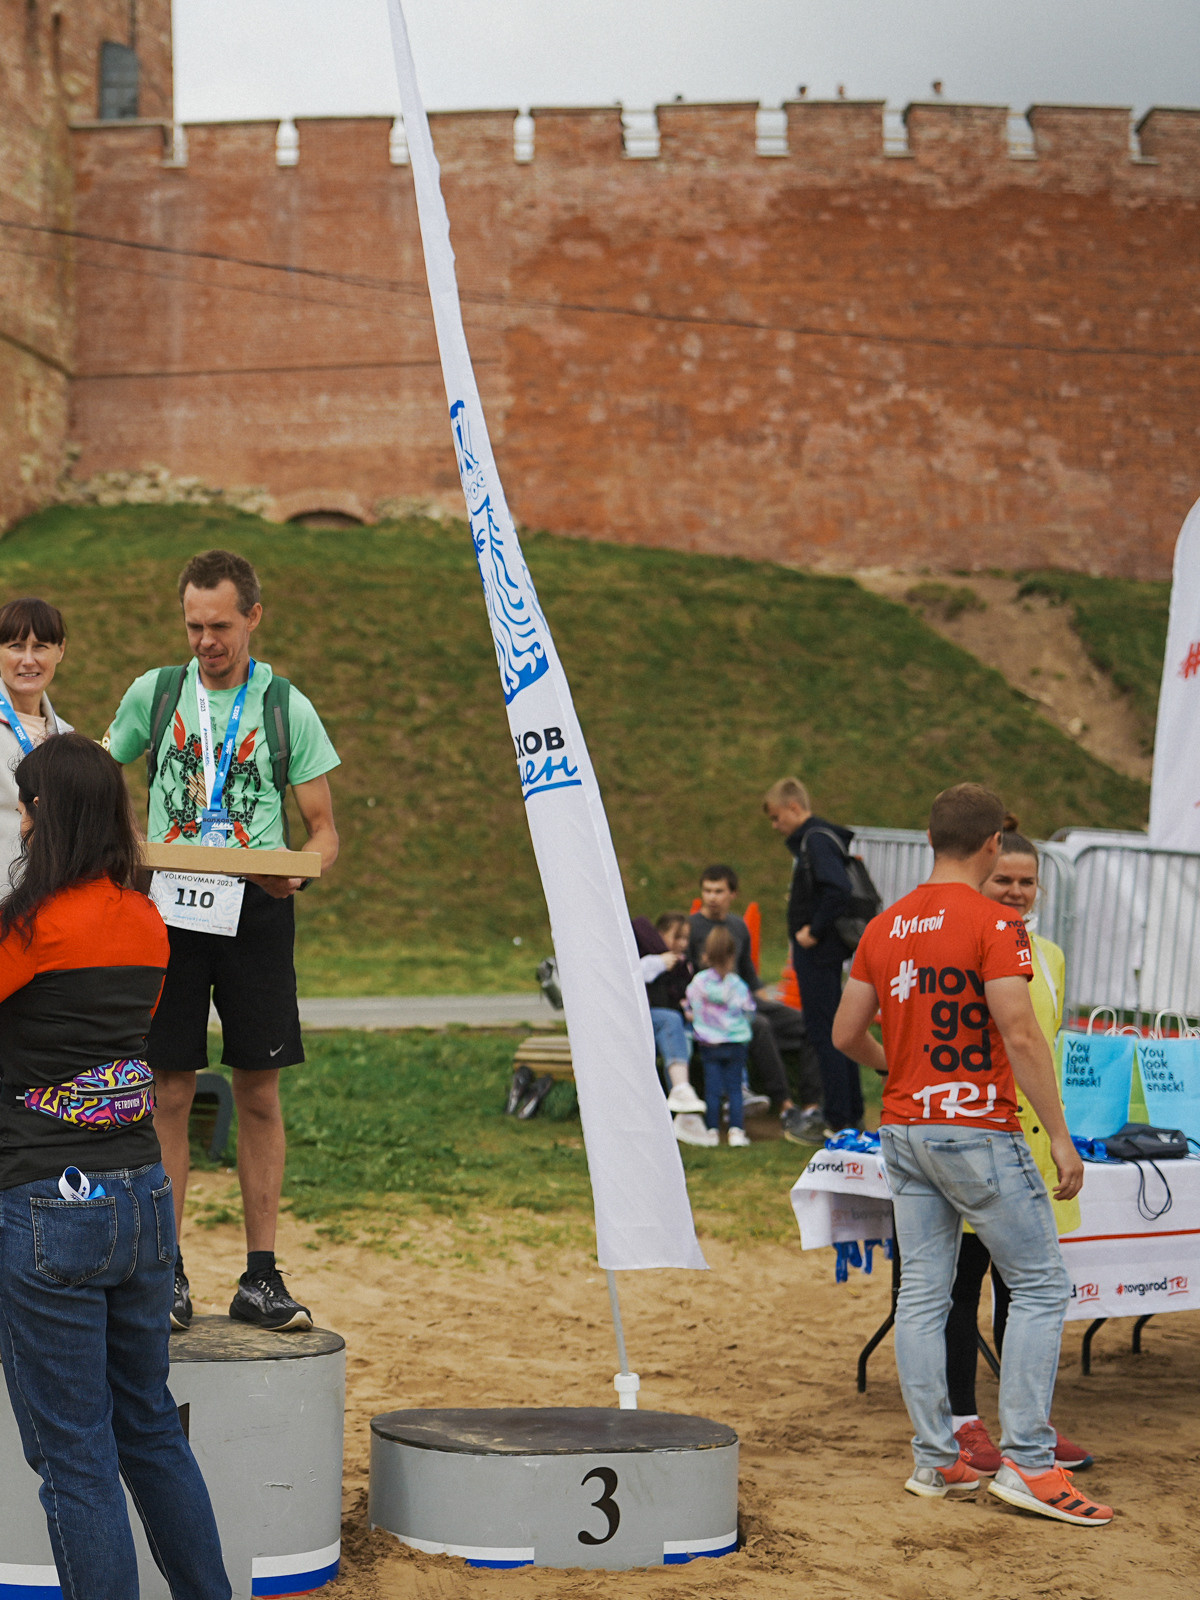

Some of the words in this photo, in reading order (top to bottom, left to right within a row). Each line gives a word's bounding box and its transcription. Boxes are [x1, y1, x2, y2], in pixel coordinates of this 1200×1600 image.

[165, 873, 215, 884] VOLKHOVMAN
[175, 888, 214, 908] 110
[931, 1001, 989, 1041] go
[924, 1029, 992, 1072] od
[1068, 1041, 1090, 1051] You
[1067, 1053, 1090, 1064] look
[1139, 1047, 1164, 1059] You
[1066, 1064, 1085, 1075] like
[1143, 1059, 1168, 1069] look
[1065, 1075, 1102, 1088] snack!
[1144, 1070, 1166, 1080] like
[1168, 1073, 1174, 1081] a
[1146, 1081, 1185, 1093] snack!
[912, 1082, 997, 1118] TRI
[578, 1467, 619, 1546] 3
